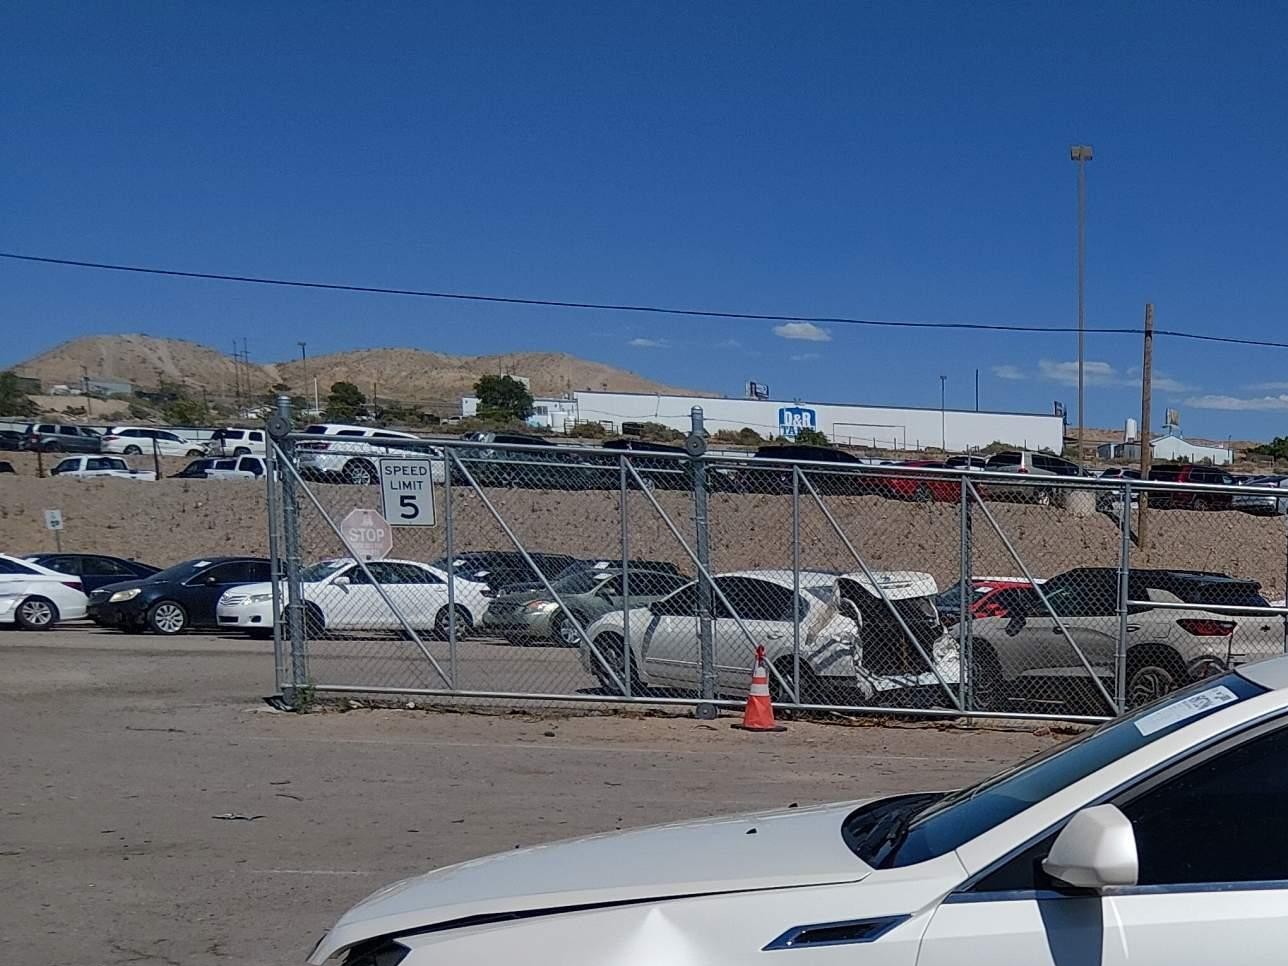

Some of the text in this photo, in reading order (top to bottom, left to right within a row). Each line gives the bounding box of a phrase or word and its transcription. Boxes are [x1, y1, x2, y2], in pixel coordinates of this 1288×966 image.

[385, 466, 427, 476] SPEED
[390, 481, 424, 490] LIMIT
[399, 496, 419, 519] 5
[349, 529, 384, 542] STOP
